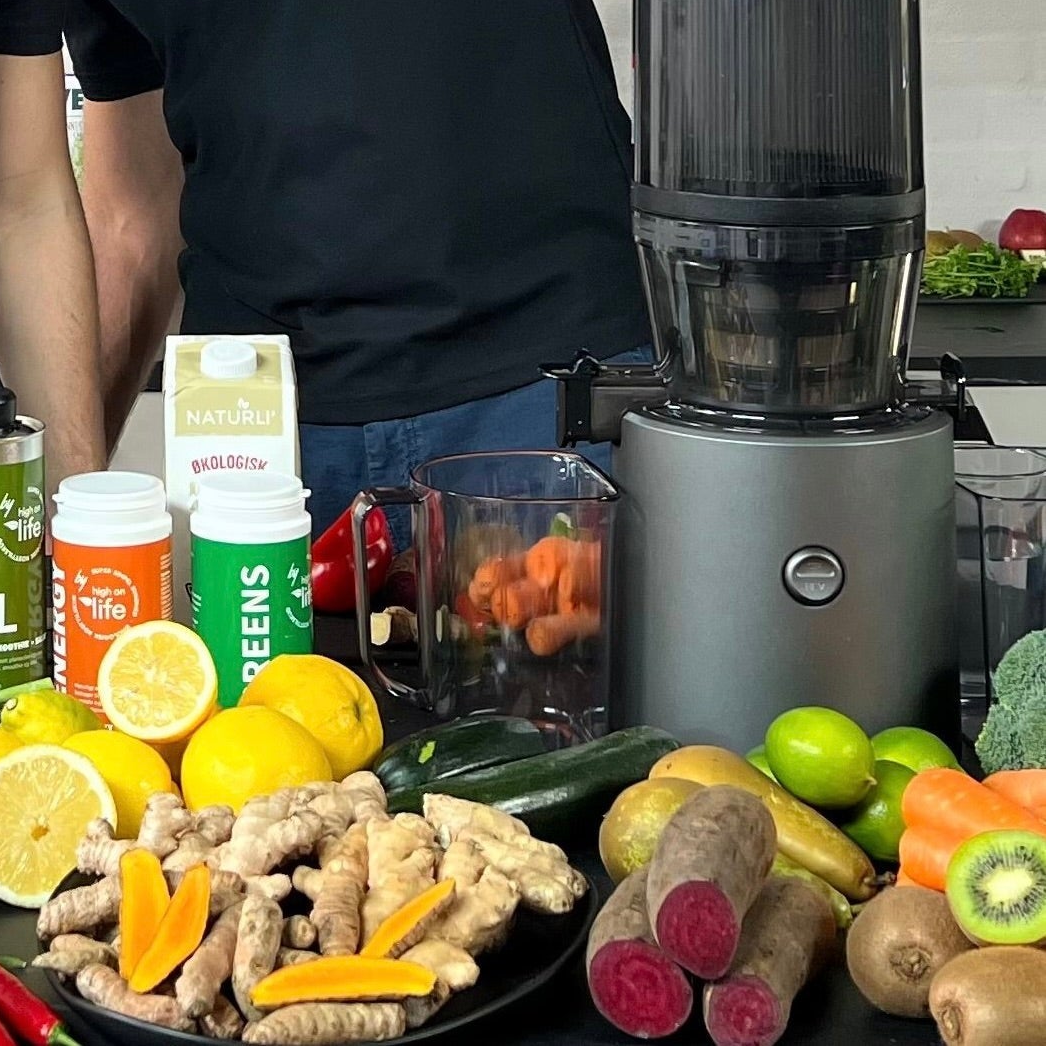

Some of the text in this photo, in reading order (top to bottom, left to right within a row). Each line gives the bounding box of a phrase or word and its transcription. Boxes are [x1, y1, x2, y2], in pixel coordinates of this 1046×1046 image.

[191, 454, 269, 475] ØKOLOGISK
[18, 516, 42, 542] life
[92, 586, 126, 598] high on
[92, 597, 127, 621] life
[240, 564, 271, 683] REENS
